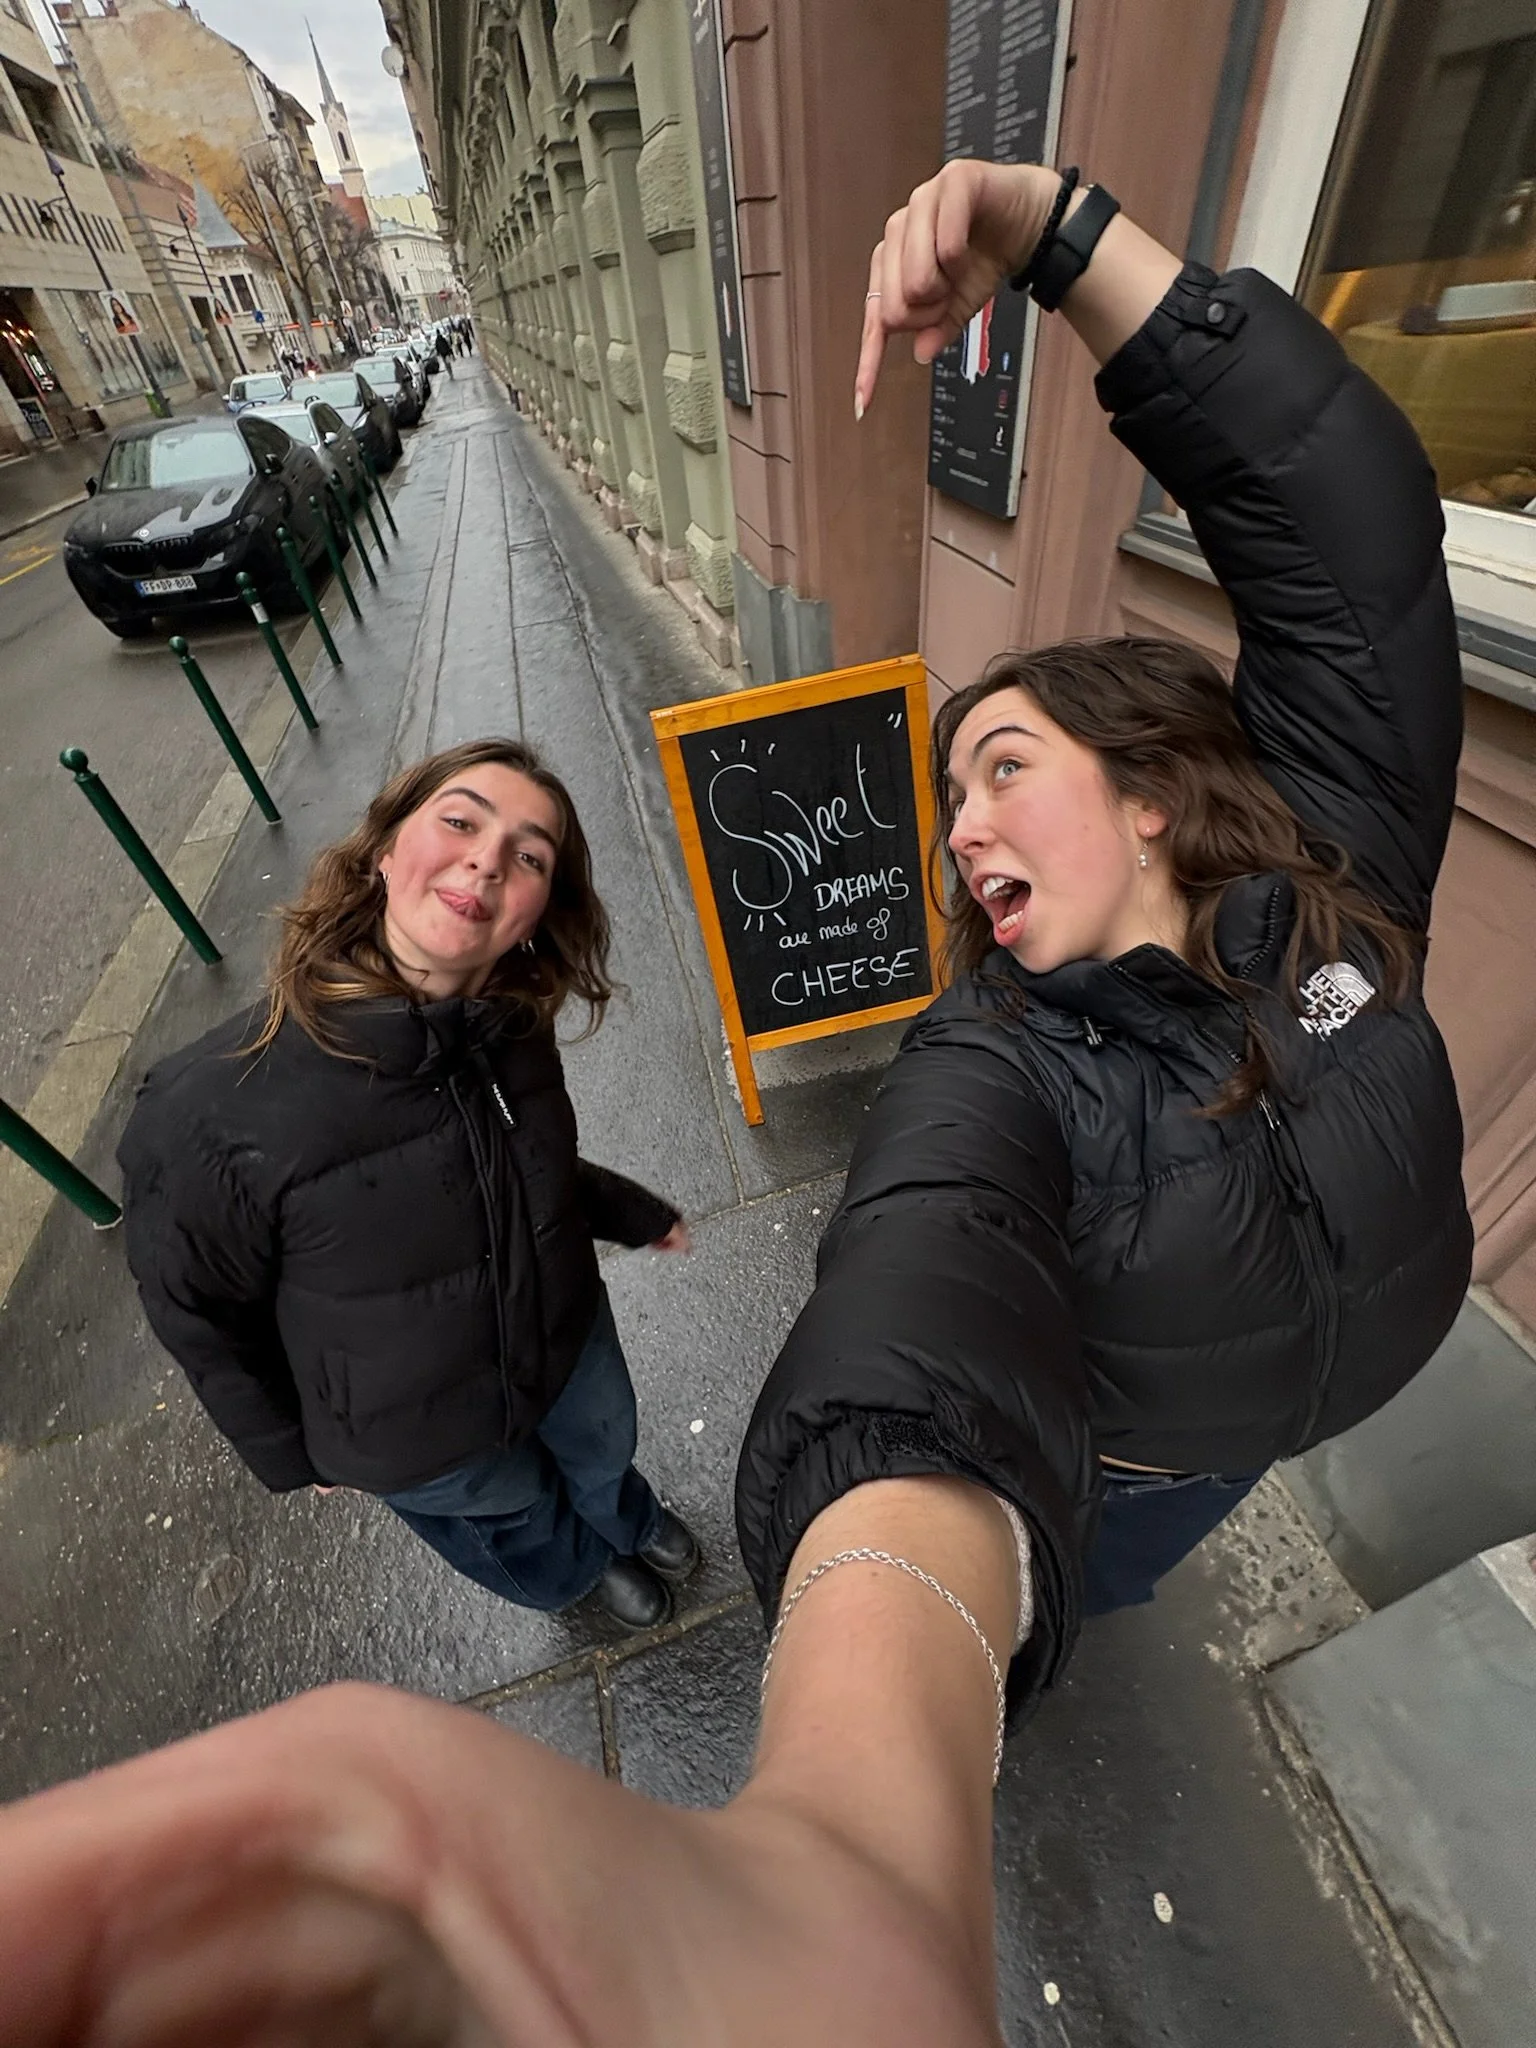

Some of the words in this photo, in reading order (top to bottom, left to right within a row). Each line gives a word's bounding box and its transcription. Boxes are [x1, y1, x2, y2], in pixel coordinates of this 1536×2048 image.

[708, 743, 897, 910] Sweet
[813, 866, 910, 912] DREAMS
[778, 930, 812, 949] are
[818, 914, 858, 941] made
[866, 907, 891, 941] of
[771, 947, 920, 1006] CHEESE
[1298, 970, 1332, 1001] HE
